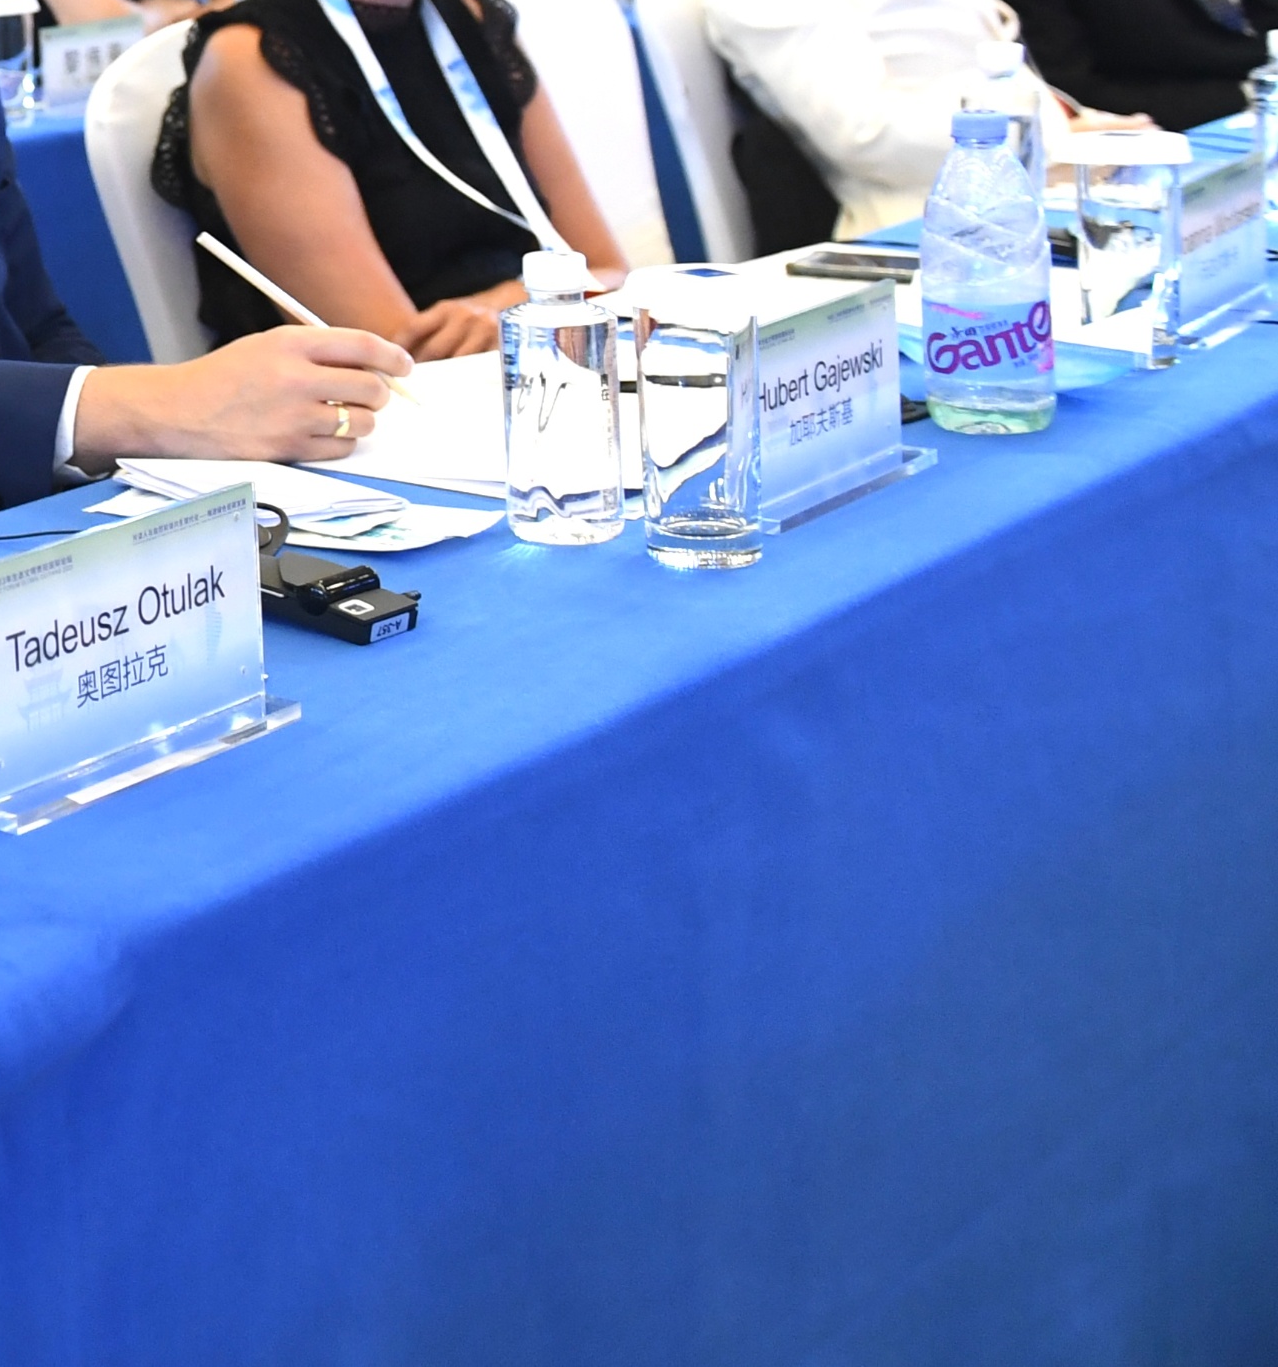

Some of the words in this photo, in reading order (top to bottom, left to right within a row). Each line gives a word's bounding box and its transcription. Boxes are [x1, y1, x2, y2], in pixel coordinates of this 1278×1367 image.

[926, 300, 1052, 375] Gante
[758, 368, 810, 413] Hubert
[813, 338, 884, 393] Gajewski
[789, 396, 854, 446] 加耶夫斯基
[6, 604, 130, 673] Tadeusz
[137, 564, 226, 625] Otulak
[76, 643, 169, 709] 奥图拉克
